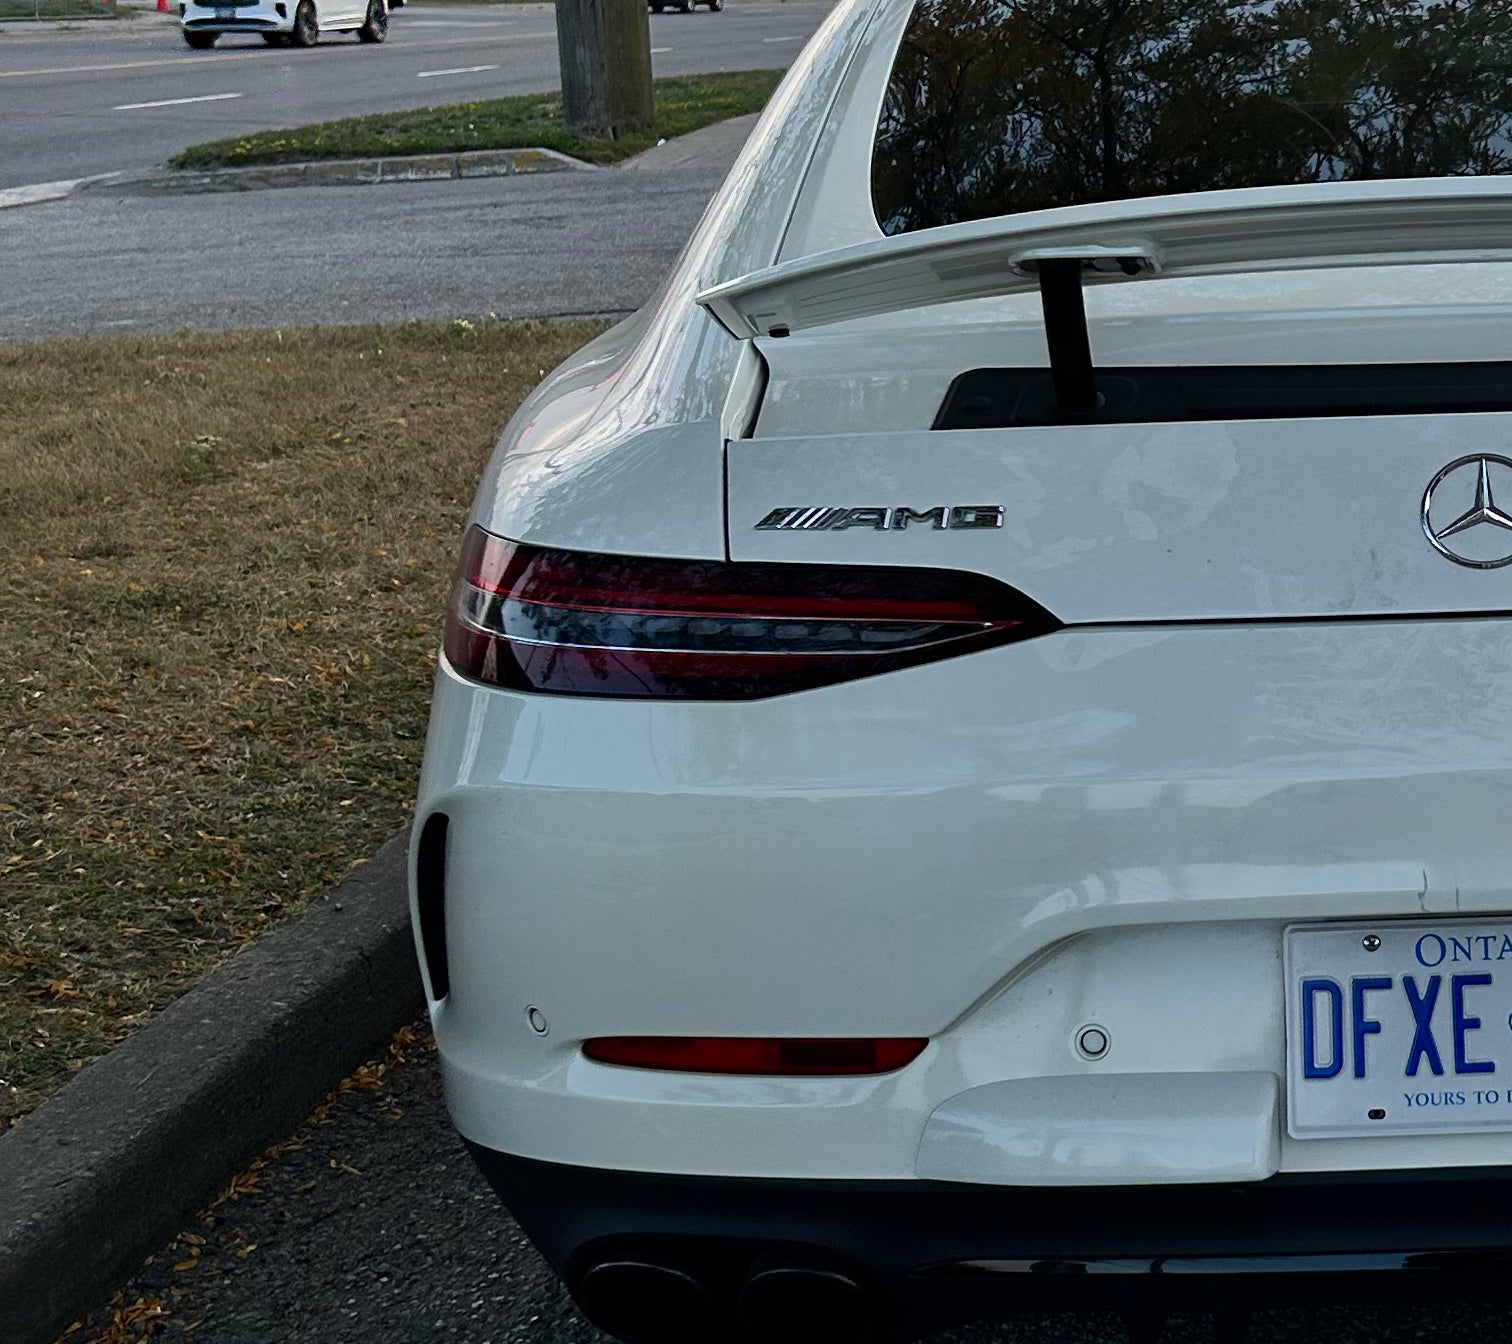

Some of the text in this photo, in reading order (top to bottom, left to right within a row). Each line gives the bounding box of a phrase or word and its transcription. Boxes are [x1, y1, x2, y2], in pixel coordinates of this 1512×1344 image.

[1301, 973, 1496, 1080] DFXE
[1404, 1091, 1466, 1107] YOURS
[1472, 1090, 1499, 1104] TO
